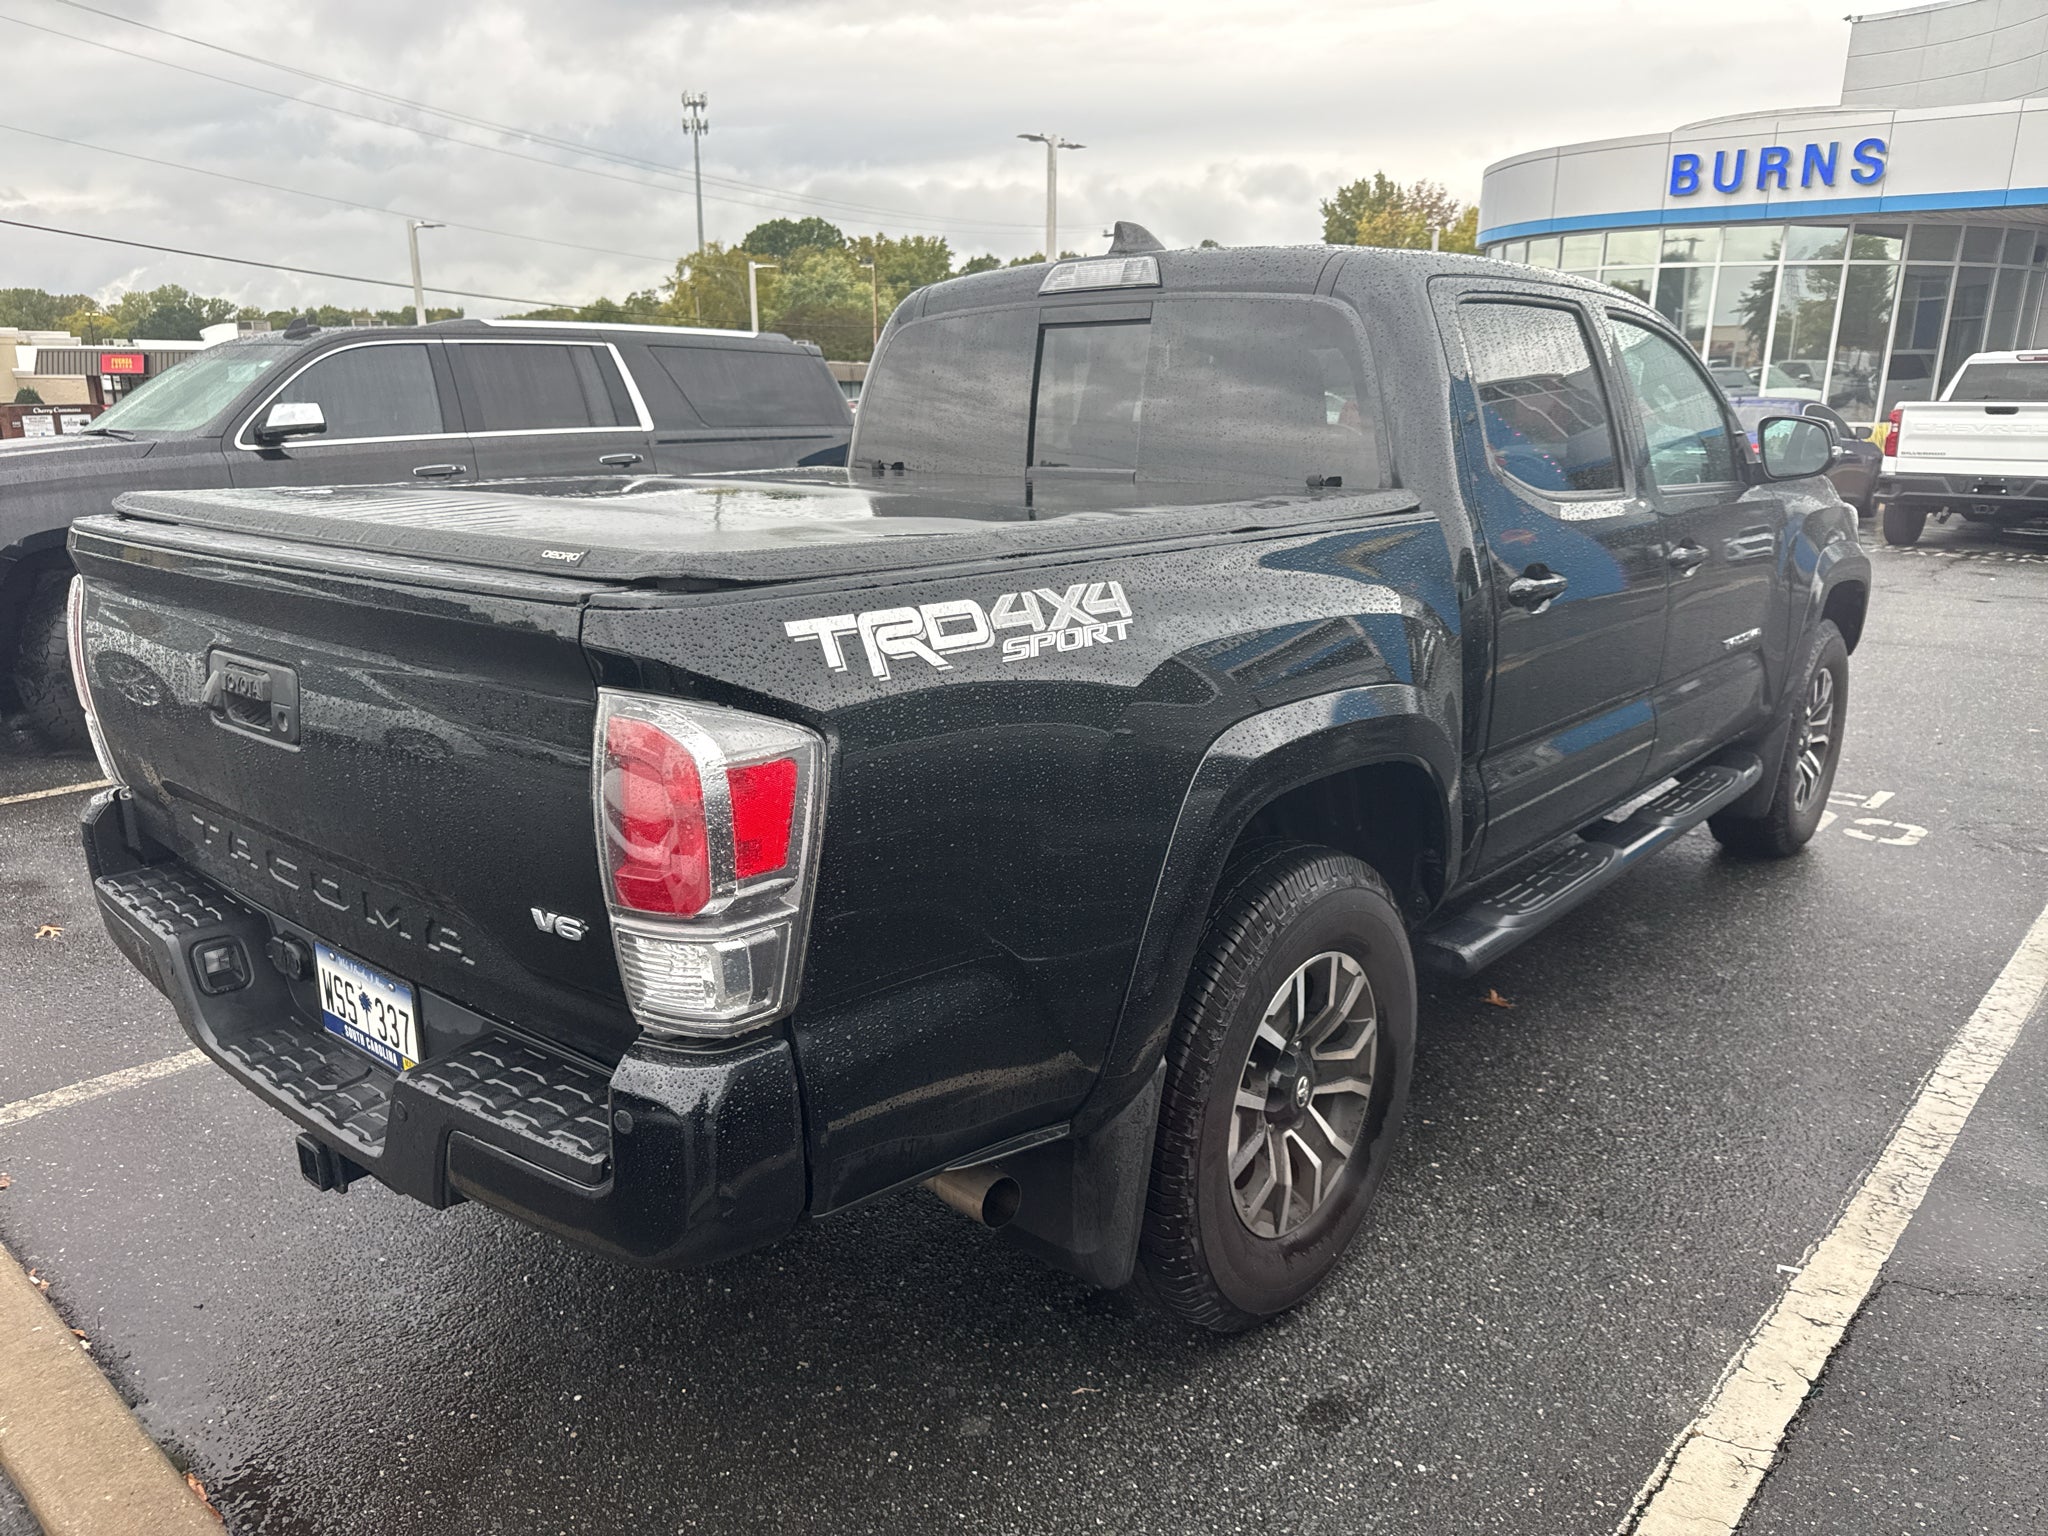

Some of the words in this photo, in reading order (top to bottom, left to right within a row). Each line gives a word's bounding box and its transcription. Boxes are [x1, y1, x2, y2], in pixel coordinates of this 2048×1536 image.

[1669, 137, 1889, 197] BURNS
[783, 599, 996, 682] TRD
[1002, 618, 1134, 664] SPORT
[191, 813, 476, 967] TACOMA
[530, 907, 590, 942] V6
[322, 967, 358, 1025] WSS
[375, 997, 409, 1055] 337
[344, 1024, 366, 1045] SOUTH
[366, 1036, 399, 1067] CAROLINA
